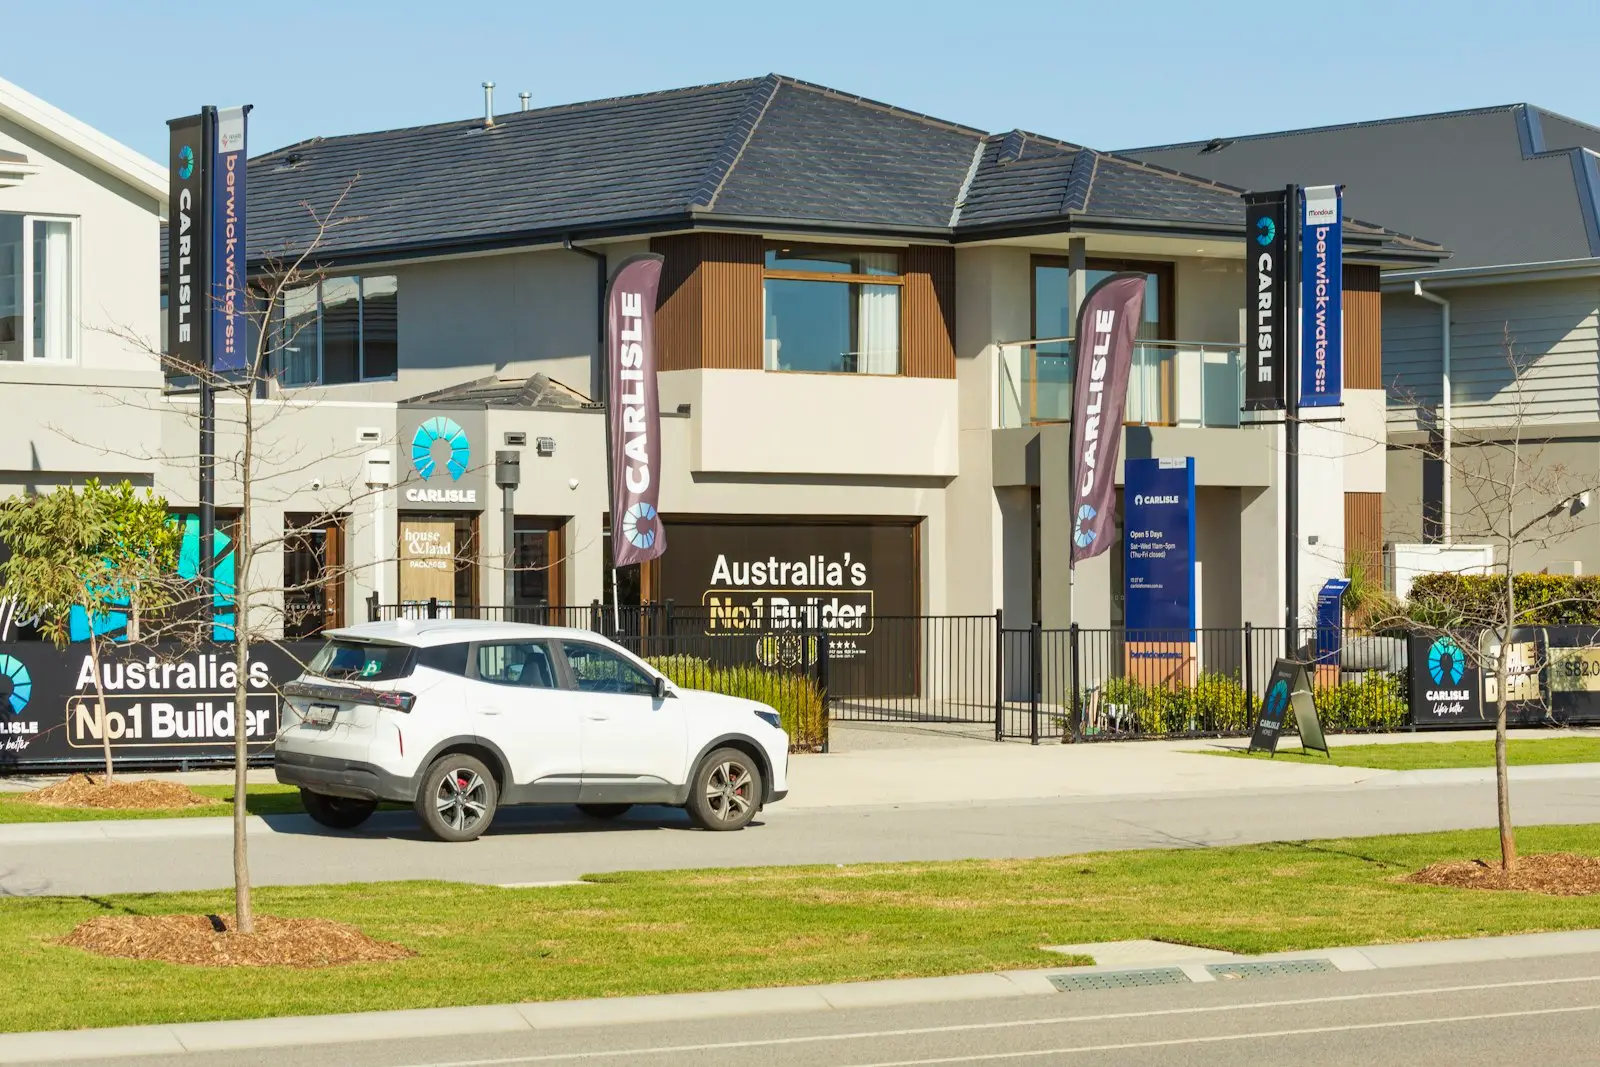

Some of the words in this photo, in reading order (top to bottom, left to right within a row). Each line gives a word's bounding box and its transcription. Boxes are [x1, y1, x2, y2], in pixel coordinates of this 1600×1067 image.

[225, 154, 238, 338] berwickwaters
[179, 187, 192, 343] CARLISLE
[1258, 252, 1273, 383] CARLISLE
[1315, 226, 1330, 380] berwickwaters
[620, 291, 651, 494] CARLISLE
[1081, 308, 1115, 497] CARLISLE
[405, 488, 477, 503] CARLISLE
[1144, 495, 1179, 505] CARLISLE
[405, 528, 441, 542] house
[1130, 530, 1144, 539] Open
[1145, 530, 1149, 538] 5
[1150, 530, 1163, 539] Days
[710, 552, 867, 586] Australia's
[710, 597, 763, 629] No.1
[771, 597, 866, 629] Builder
[1426, 690, 1469, 701] CARLISLE
[76, 703, 142, 740] No.1
[151, 702, 270, 739] Builder
[1260, 719, 1280, 730] CARLISLE
[5, 735, 30, 753] better
